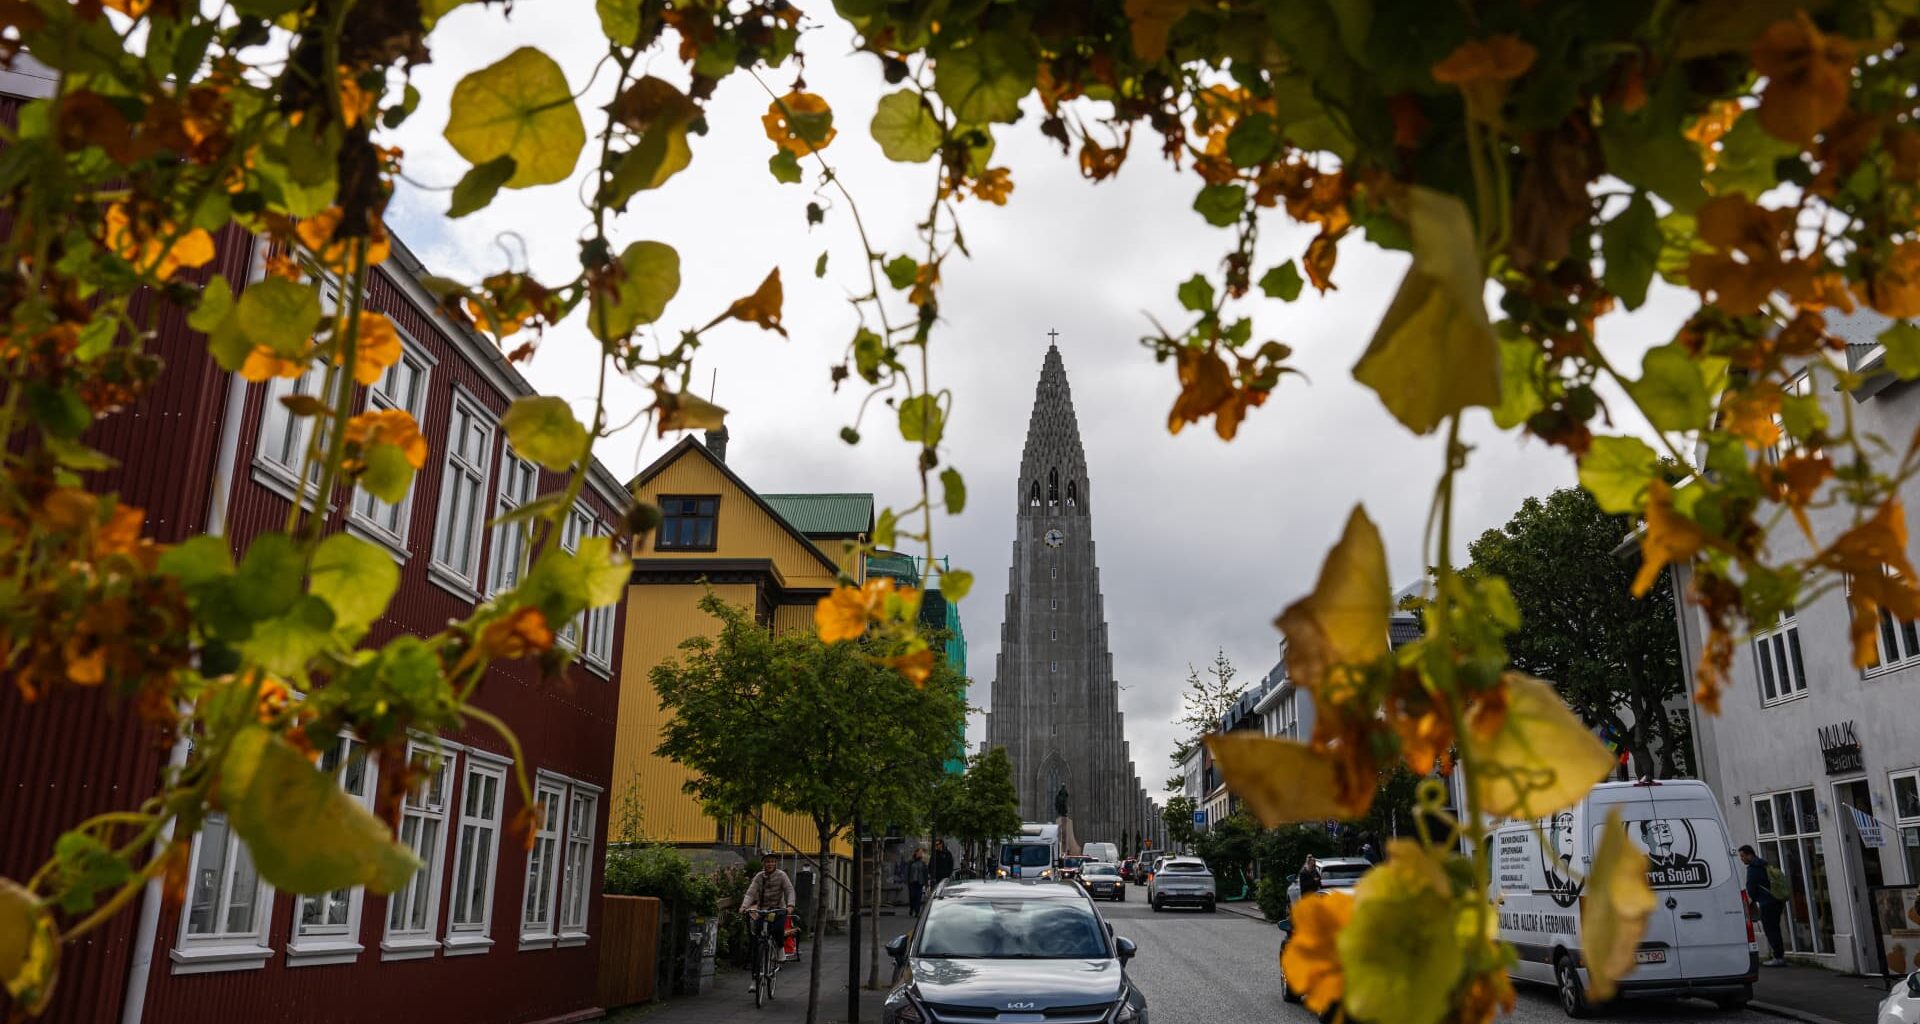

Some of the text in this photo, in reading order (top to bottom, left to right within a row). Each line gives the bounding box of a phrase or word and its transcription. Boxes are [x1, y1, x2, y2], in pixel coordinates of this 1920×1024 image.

[1818, 720, 1857, 752] MJUK
[1667, 867, 1700, 884] Snjall
[1512, 913, 1520, 931] ER
